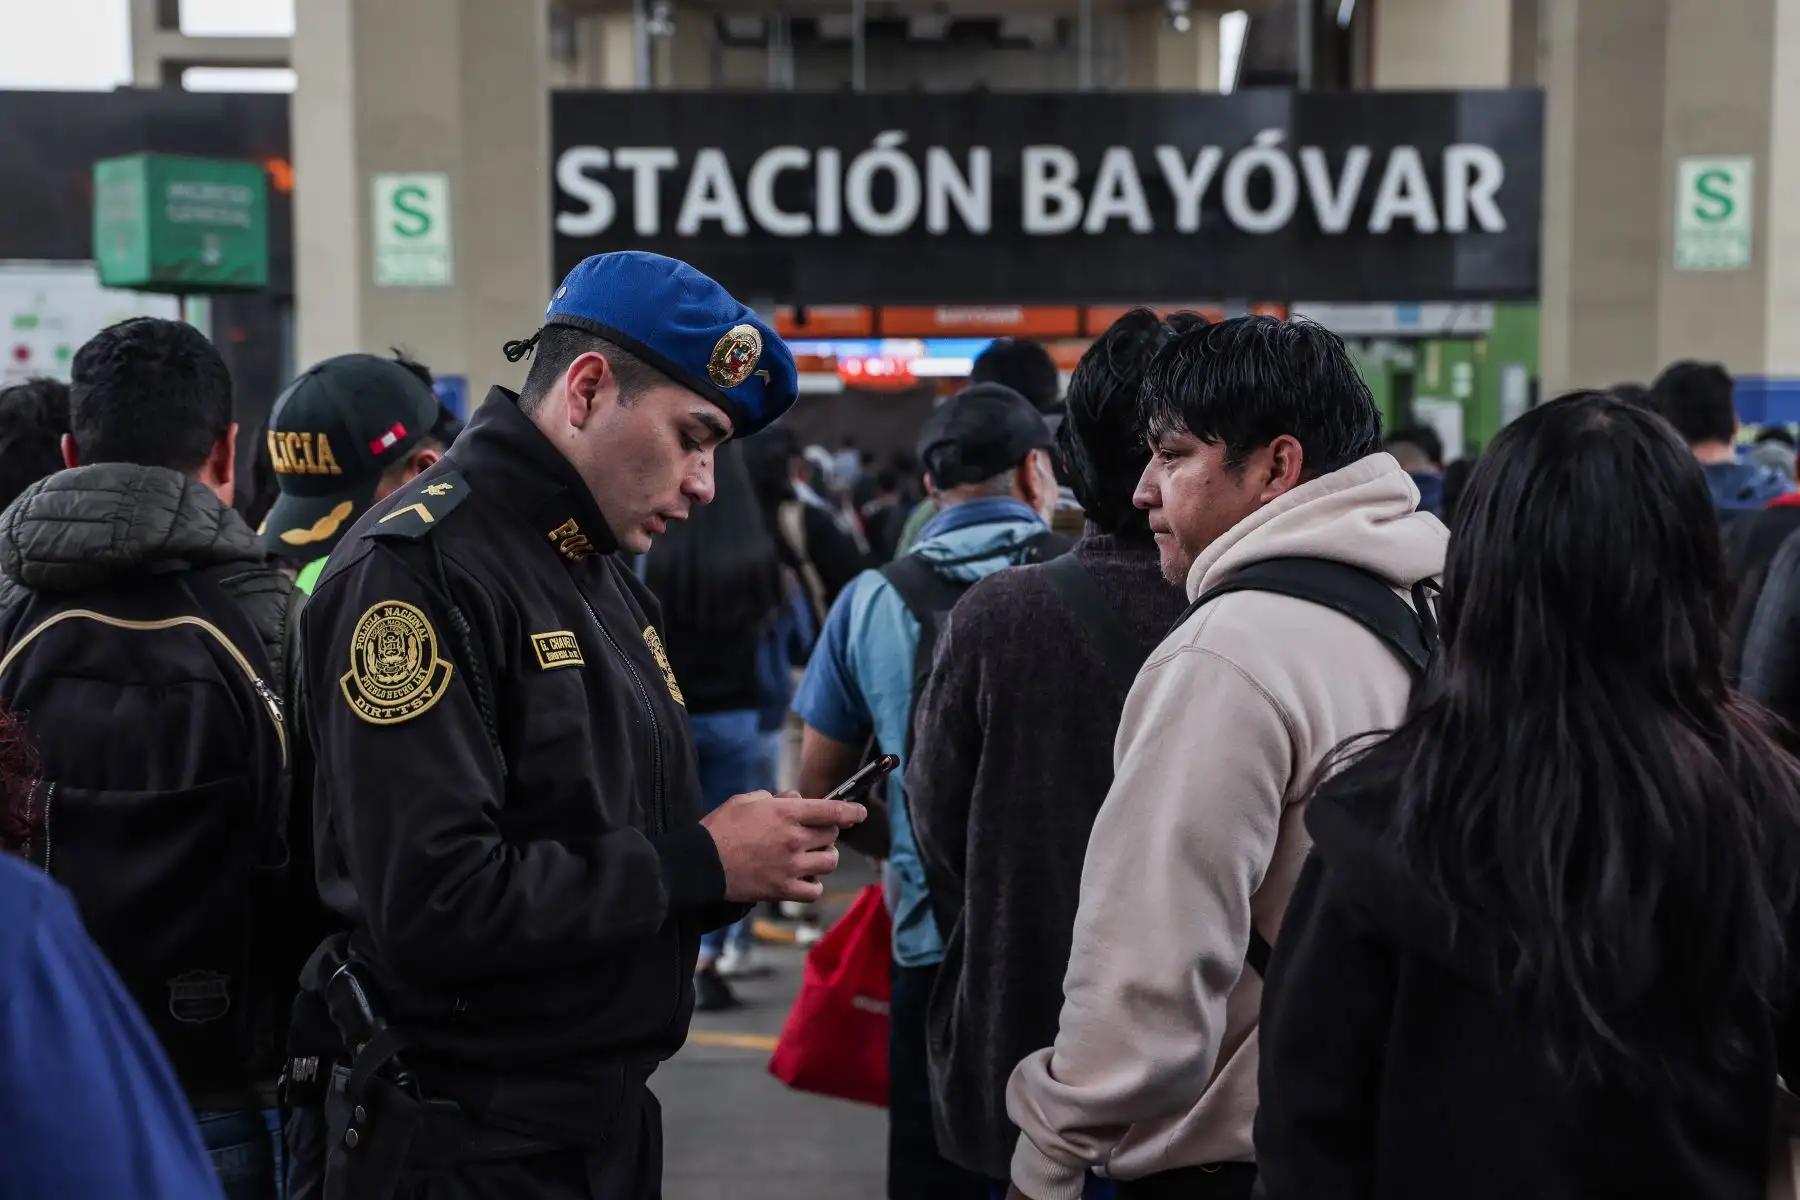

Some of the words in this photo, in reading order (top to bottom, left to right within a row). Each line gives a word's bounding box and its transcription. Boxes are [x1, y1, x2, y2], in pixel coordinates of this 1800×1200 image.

[556, 129, 992, 237] STACIÓN
[1022, 129, 1507, 234] BAYÓVAR
[1693, 168, 1736, 222] S
[392, 184, 432, 238] S
[267, 430, 343, 473] LICIA
[356, 613, 380, 650] POLICIA
[384, 608, 428, 642] NACIONAL
[540, 640, 550, 652] G.
[355, 686, 433, 717] DIRTTSV
[361, 675, 385, 699] PUEBLO
[386, 684, 414, 699] HECHO
[414, 668, 428, 685] LEY
